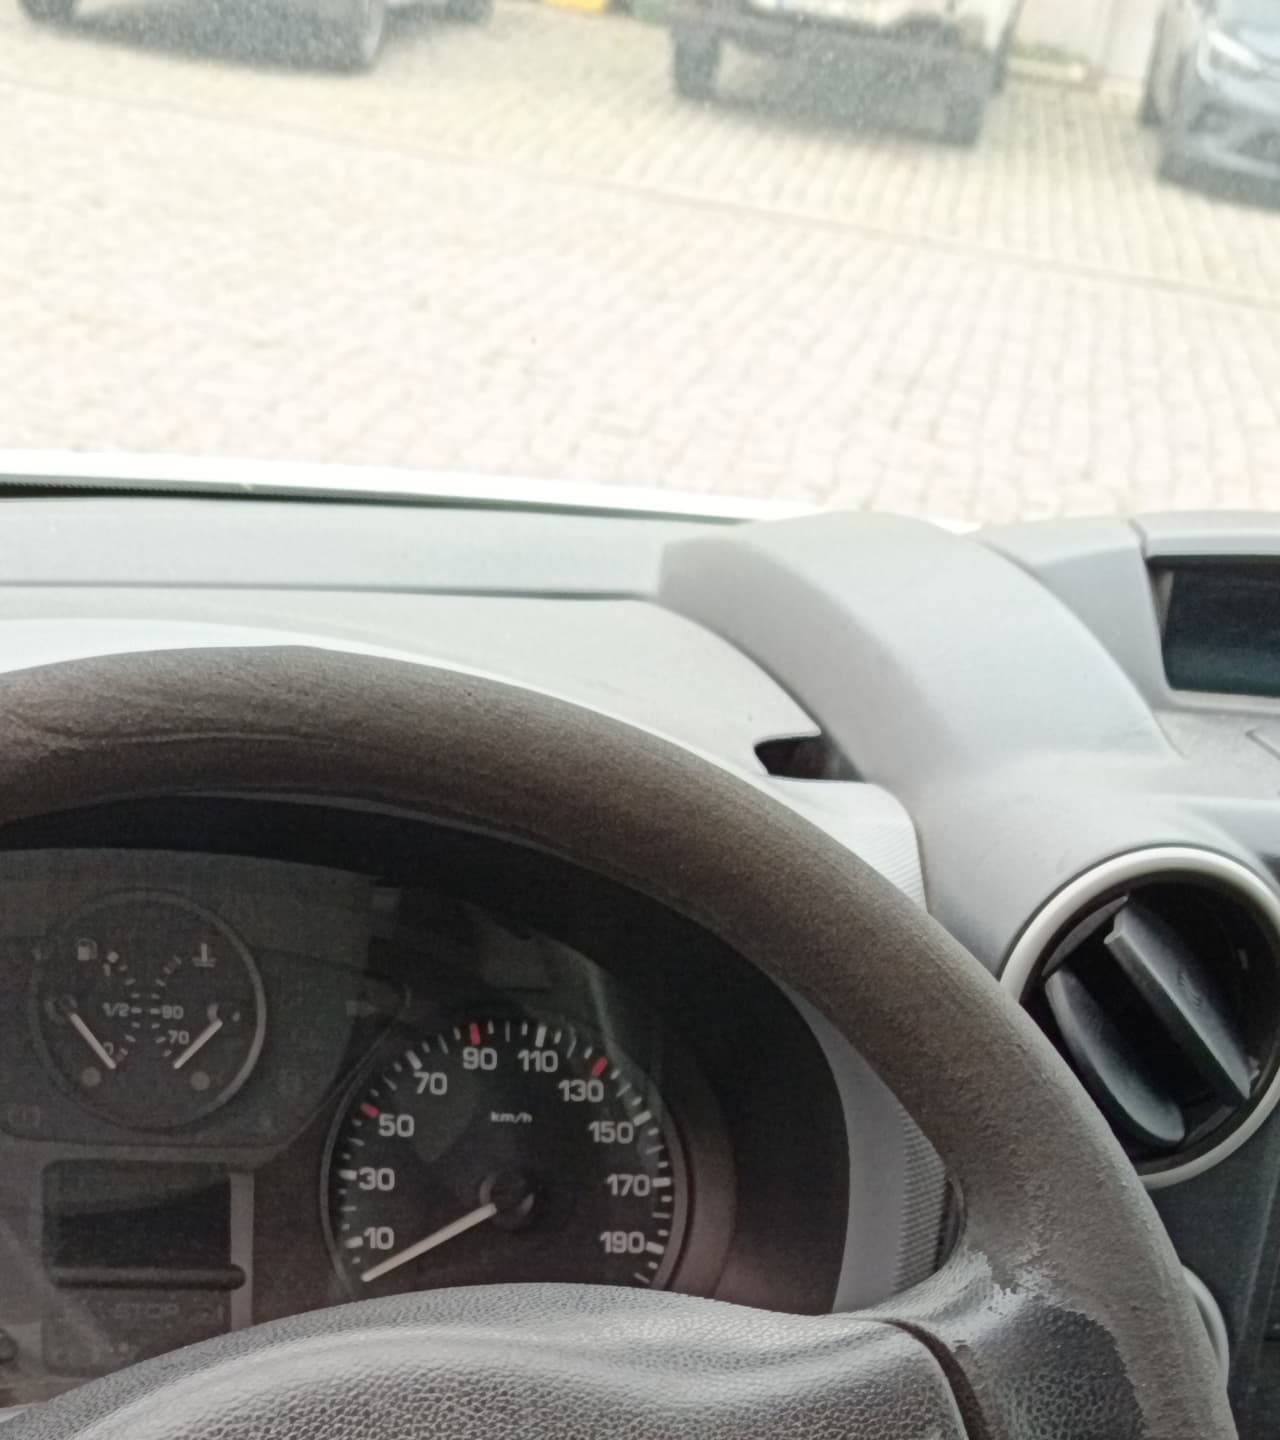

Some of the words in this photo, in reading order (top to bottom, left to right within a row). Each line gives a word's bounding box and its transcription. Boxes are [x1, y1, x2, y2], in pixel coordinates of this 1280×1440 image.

[168, 1030, 190, 1045] 70
[463, 1048, 497, 1072] 90
[518, 1050, 559, 1074] 110
[415, 1073, 448, 1097] 70
[559, 1078, 605, 1103] 130
[379, 1113, 414, 1138] 50
[490, 1110, 533, 1124] km/h
[589, 1120, 634, 1145] 150
[359, 1168, 395, 1191] 30
[607, 1173, 651, 1197] 170
[364, 1227, 395, 1251] 10
[600, 1231, 646, 1255] 190
